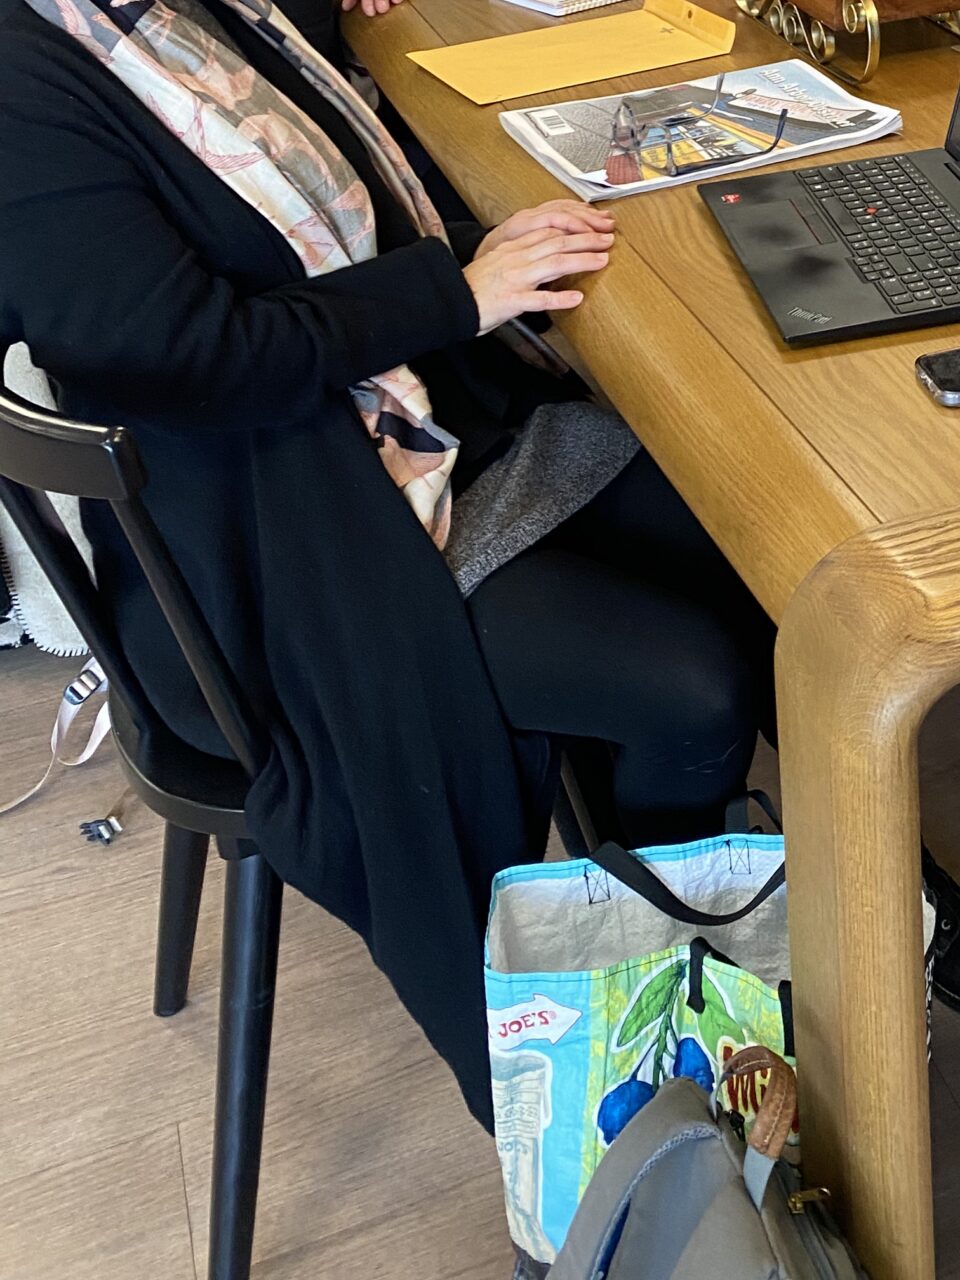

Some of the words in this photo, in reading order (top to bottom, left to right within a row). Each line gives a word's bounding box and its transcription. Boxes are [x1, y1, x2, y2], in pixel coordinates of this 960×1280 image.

[760, 68, 786, 84] Ann
[787, 306, 832, 324] ThinkPad
[498, 1010, 550, 1037] JOE'S
